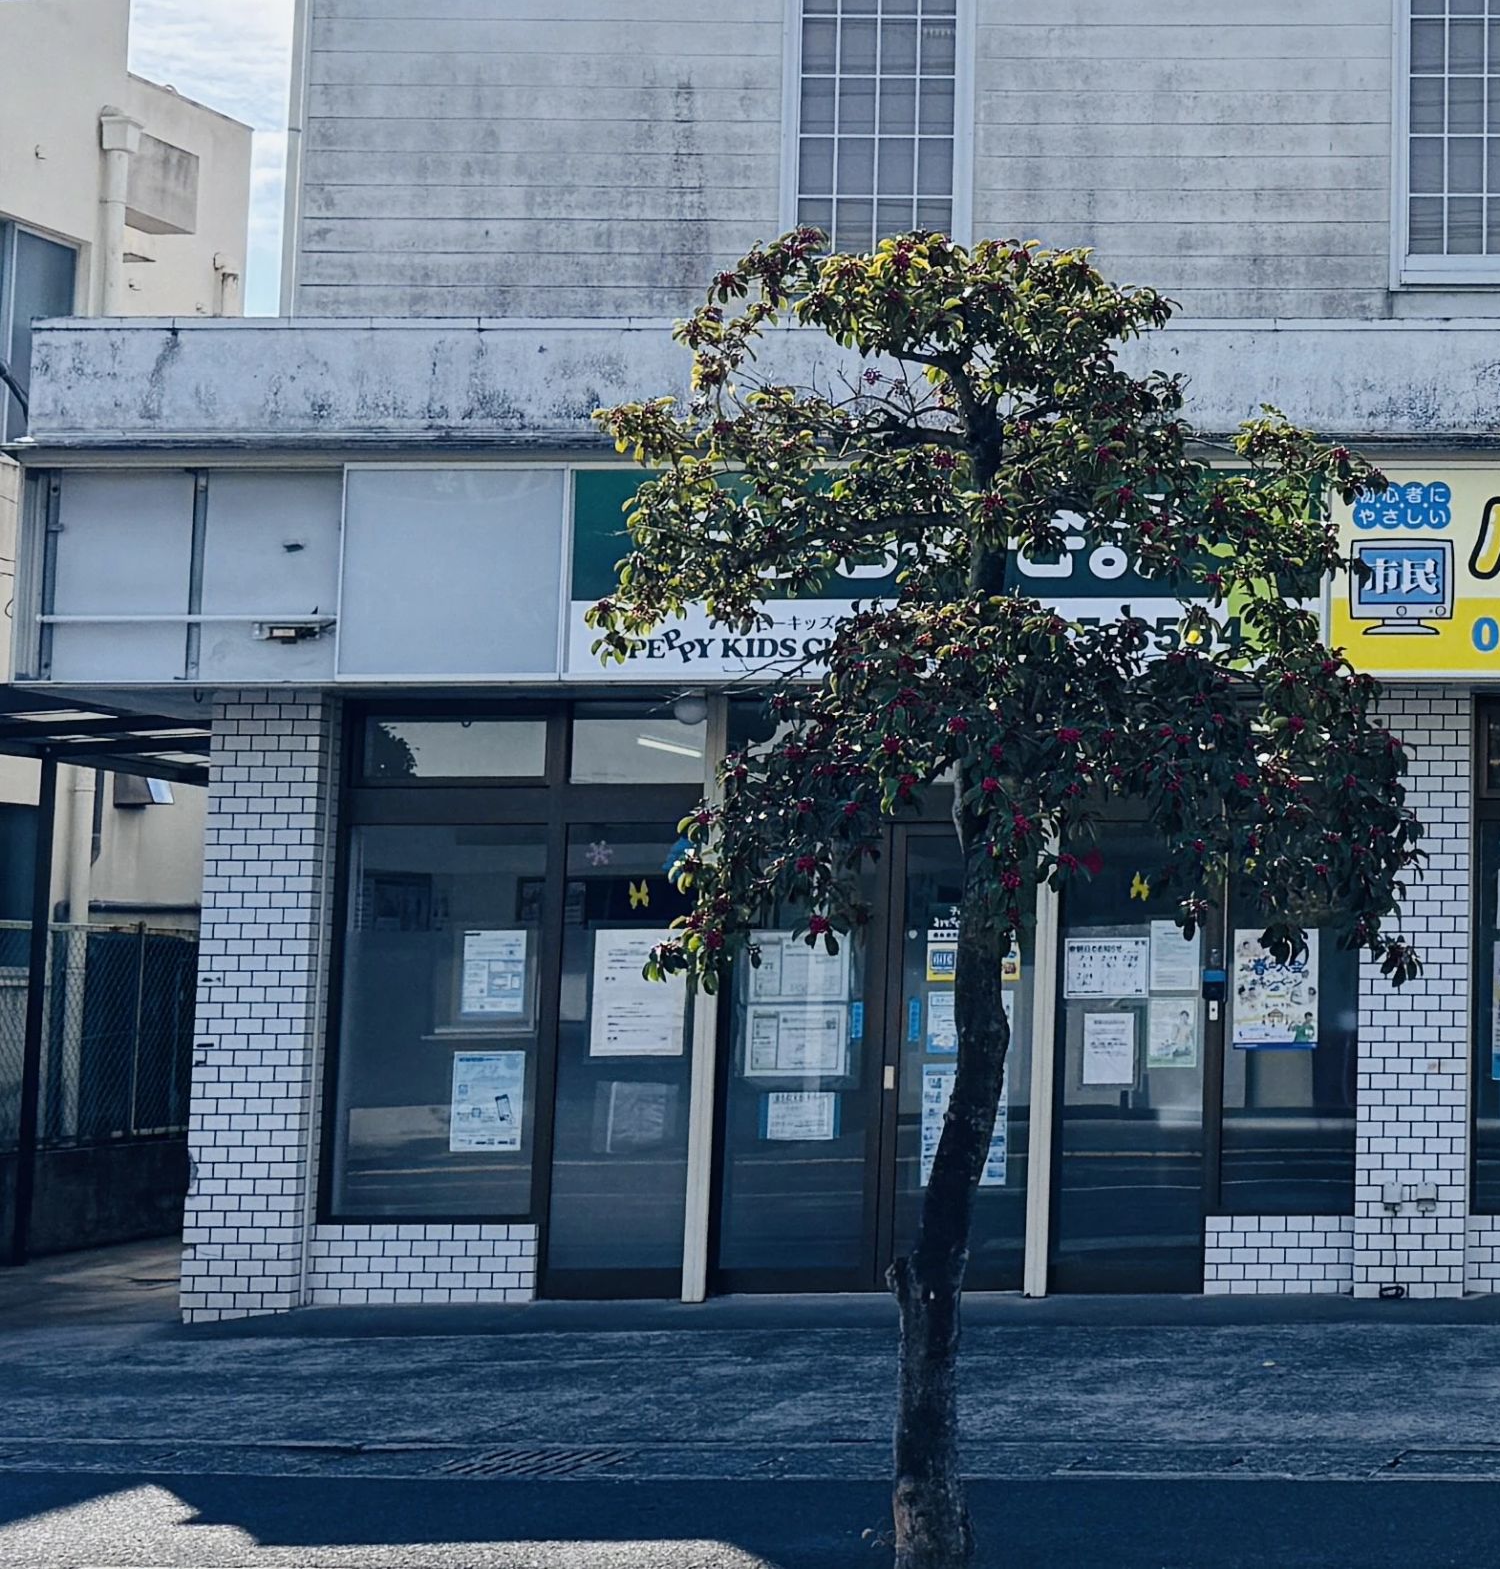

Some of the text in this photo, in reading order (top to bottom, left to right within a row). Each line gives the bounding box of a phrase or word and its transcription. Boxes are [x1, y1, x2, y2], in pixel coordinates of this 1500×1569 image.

[1359, 509, 1446, 524] やさしい
[1364, 557, 1440, 595] 市民
[628, 628, 716, 663] PEPPY
[721, 637, 797, 659] KIDS
